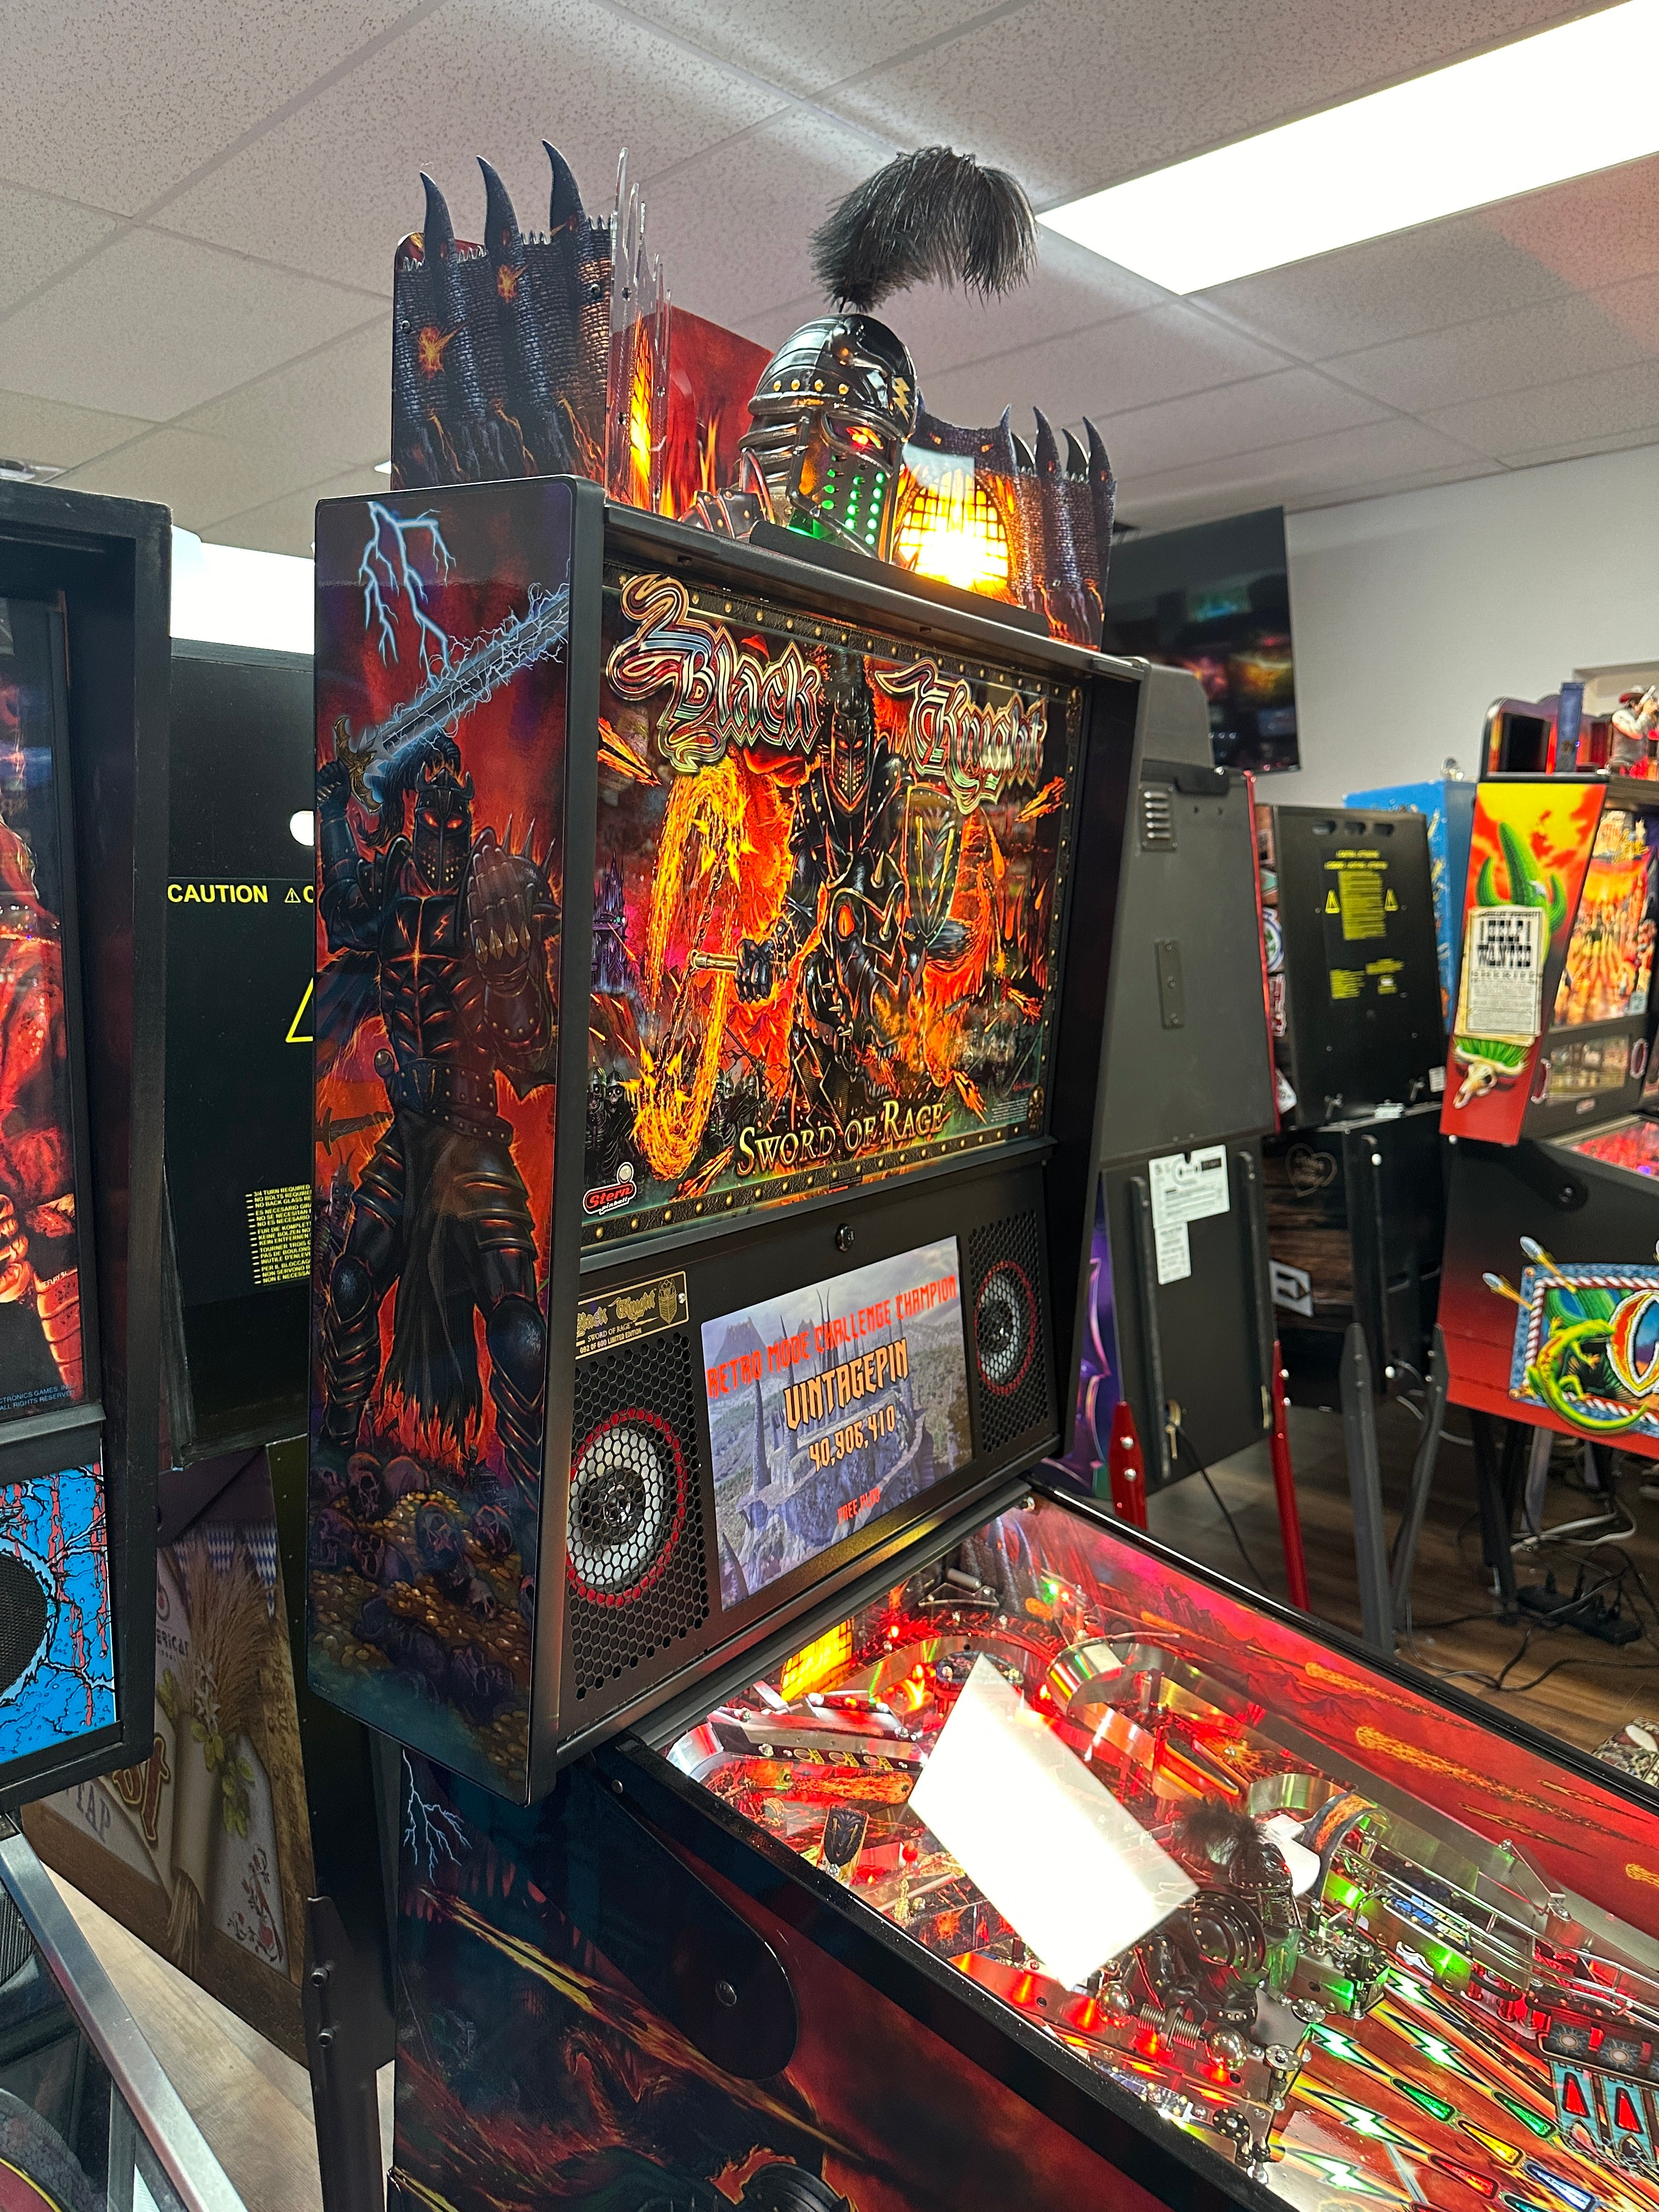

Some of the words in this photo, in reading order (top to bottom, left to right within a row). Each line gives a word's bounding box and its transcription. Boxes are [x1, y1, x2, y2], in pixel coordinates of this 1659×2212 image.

[608, 574, 823, 774] Black
[876, 658, 1048, 815] Knight
[168, 884, 268, 903] CAUTION
[737, 1126, 835, 1176] SWORD
[846, 1118, 877, 1153] OF
[879, 1100, 945, 1146] RAGE
[281, 1184, 310, 1193] REQUIRED
[590, 1187, 630, 1206] Stern
[265, 1204, 298, 1214] NECESARIO
[276, 1209, 308, 1218] NECESITAN
[601, 1197, 628, 1211] pinball
[276, 1214, 309, 1224] NECESARIO
[260, 1243, 287, 1253] TOURNER
[588, 1330, 607, 1342] SWORD
[617, 1323, 631, 1333] RAGE
[597, 1340, 606, 1348] 600
[608, 1333, 624, 1345] LIMITED
[625, 1328, 642, 1340] EDITION
[706, 1351, 761, 1399] RETRO
[767, 1331, 809, 1373] MODE
[815, 1300, 891, 1353] CHALLENGE
[896, 1274, 957, 1321] CHAMPION
[13, 1398, 38, 1408] RIGHTS
[40, 1390, 75, 1401] RESERVED
[809, 1404, 895, 1471] 40,906,410
[837, 1500, 858, 1525] FREE
[860, 1487, 881, 1513] PLAY
